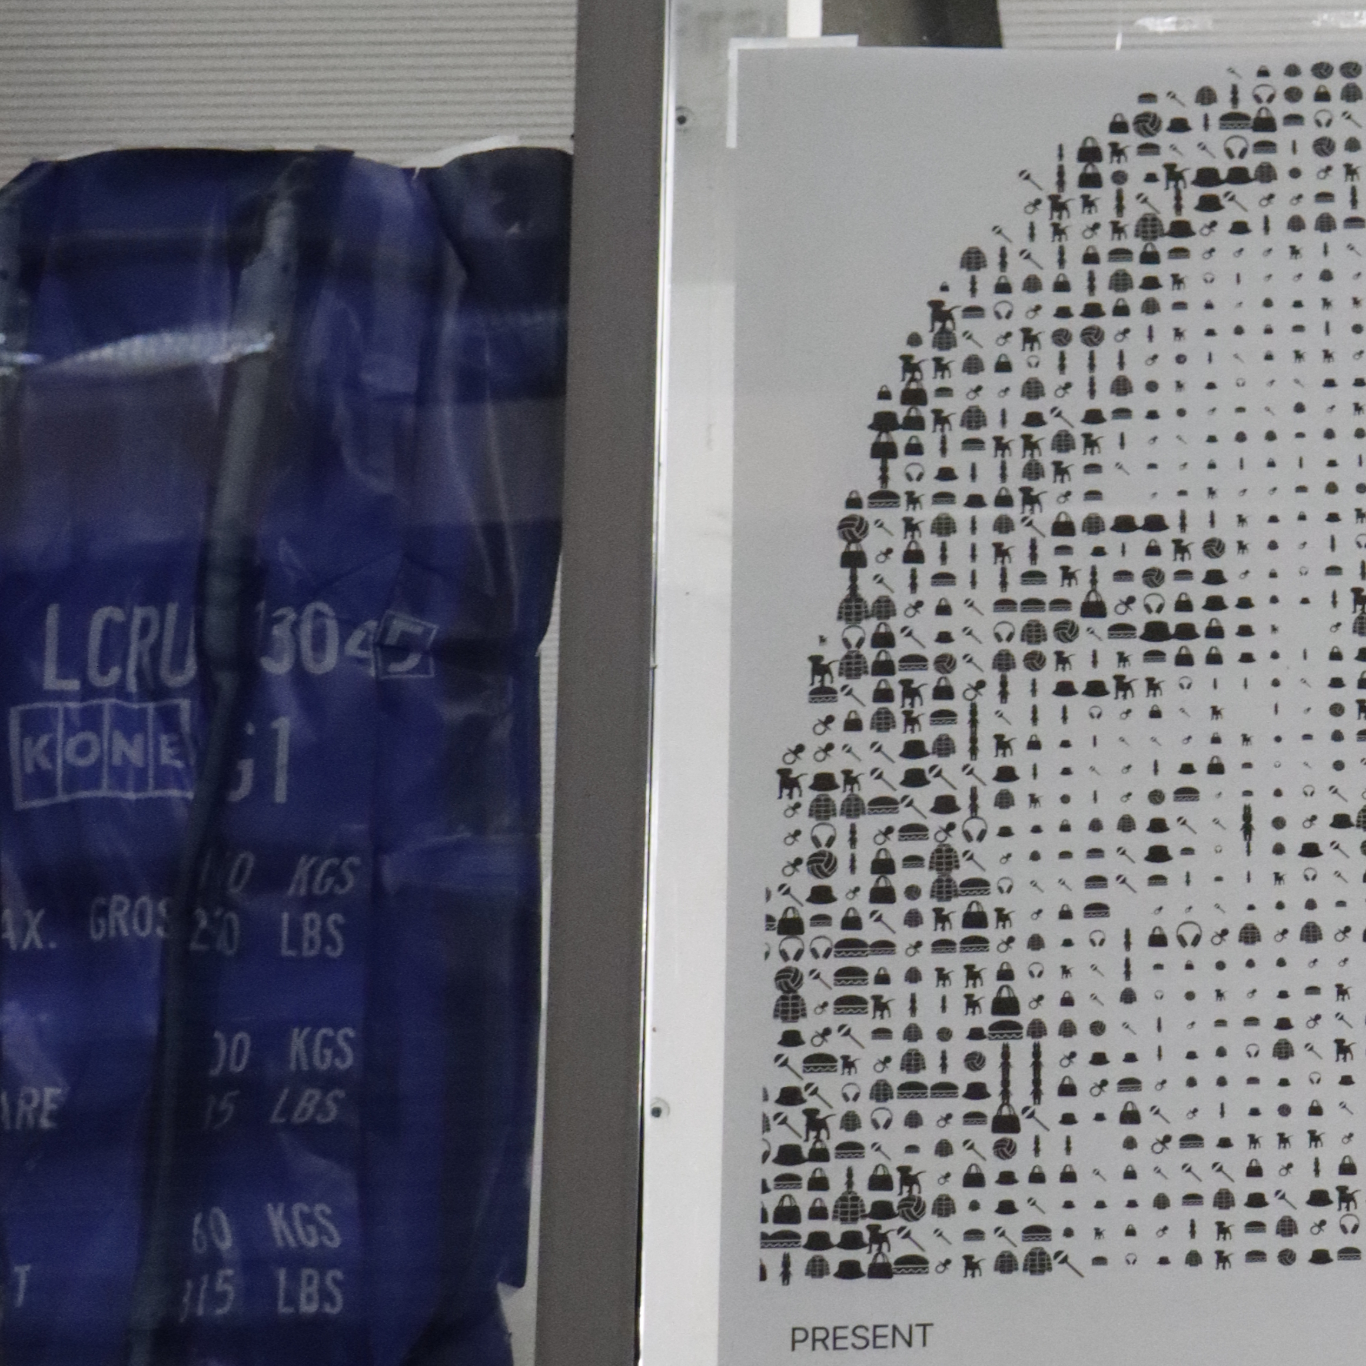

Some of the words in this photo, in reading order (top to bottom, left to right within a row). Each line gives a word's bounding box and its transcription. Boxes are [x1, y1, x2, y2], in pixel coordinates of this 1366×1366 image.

[42, 600, 198, 694] LCRU
[21, 729, 188, 775] KONE
[286, 853, 361, 897] KGS
[279, 910, 346, 958] LBS
[289, 1026, 357, 1073] KGS
[268, 1086, 347, 1126] LBS
[265, 1201, 342, 1249] KGS
[276, 1266, 345, 1315] LBS
[790, 1322, 935, 1352] PRESENT
